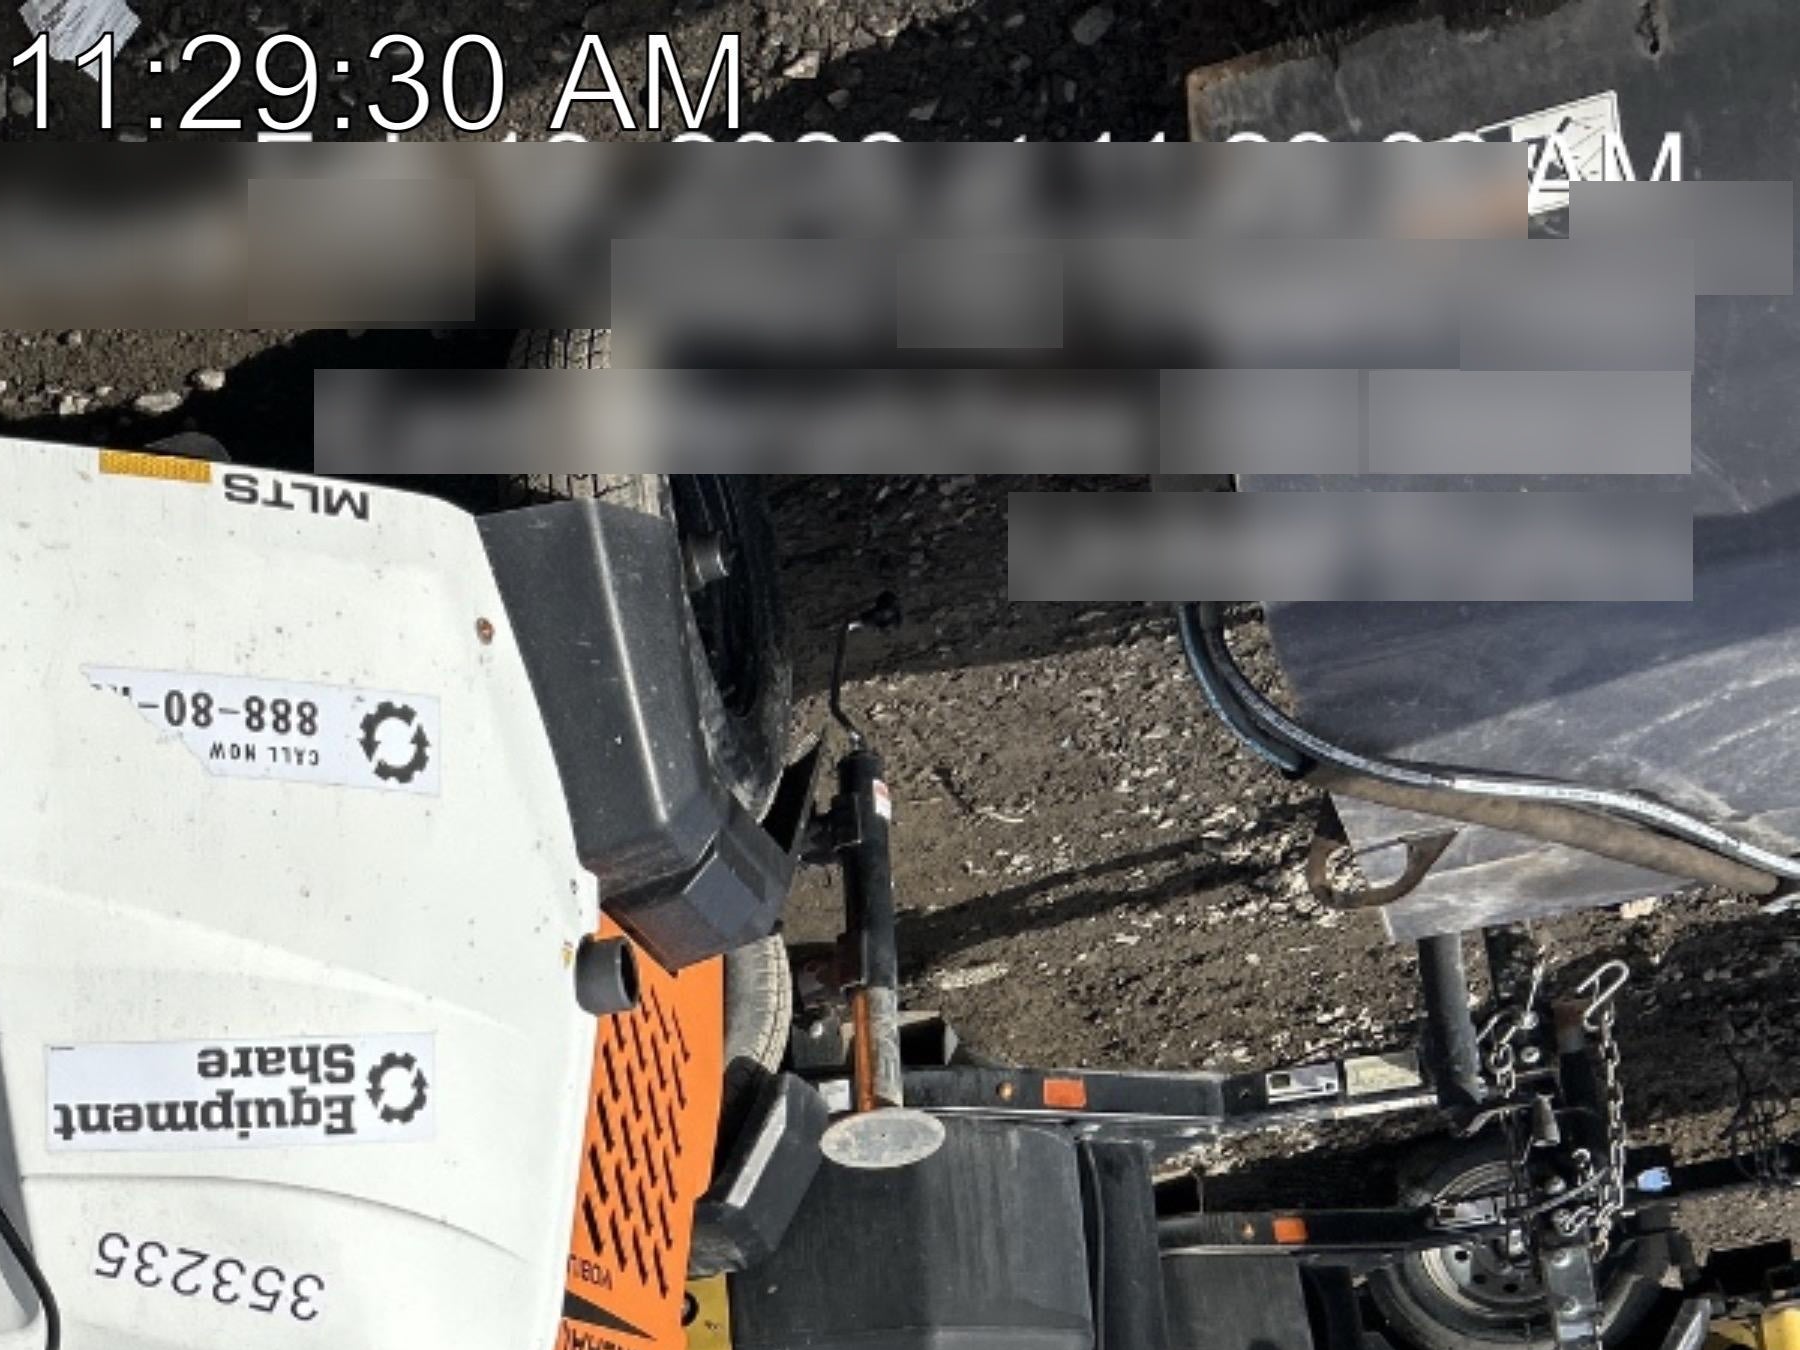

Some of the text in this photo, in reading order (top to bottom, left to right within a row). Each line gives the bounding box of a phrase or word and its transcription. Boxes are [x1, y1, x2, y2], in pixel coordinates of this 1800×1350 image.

[223, 471, 371, 522] MLTS
[209, 741, 319, 766] CALL NOW
[197, 1043, 355, 1084] Share
[54, 1087, 357, 1141] Equipment
[94, 1232, 325, 1321] 353235
